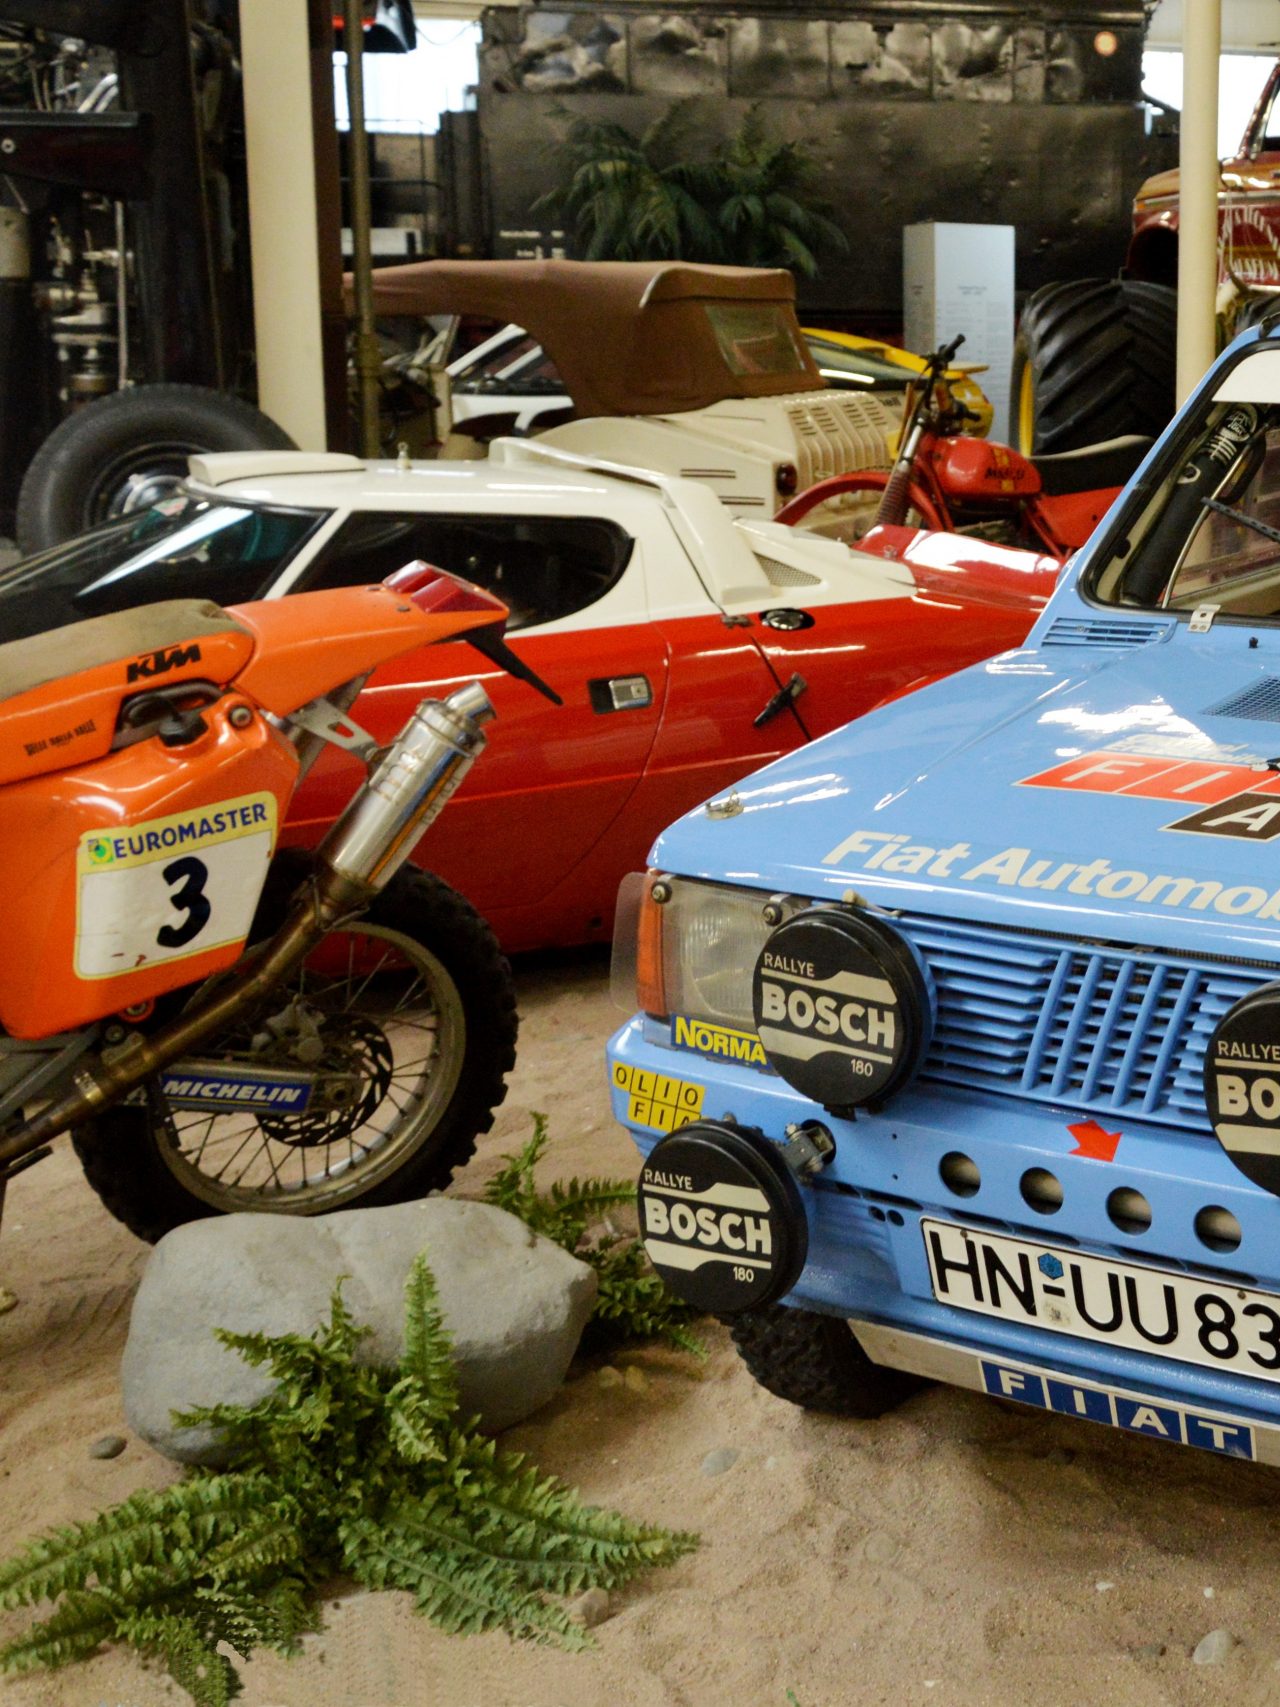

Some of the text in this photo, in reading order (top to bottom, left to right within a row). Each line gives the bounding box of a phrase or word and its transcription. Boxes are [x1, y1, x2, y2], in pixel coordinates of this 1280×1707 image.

[127, 644, 202, 682] KTM
[113, 802, 267, 859] EUROMASTER
[821, 830, 970, 881] Fiat
[156, 856, 211, 948] 3
[763, 952, 815, 978] RALLYE
[761, 982, 896, 1049] BOSCH
[674, 1017, 768, 1066] NORMA
[614, 1066, 700, 1107] OLIO
[850, 1058, 873, 1078] 180
[162, 1080, 302, 1103] MICHELIN
[644, 1168, 693, 1192] RALLYE
[643, 1196, 773, 1256] BOSCH
[732, 1265, 755, 1284] 180
[999, 1370, 1238, 1449] FIAT
